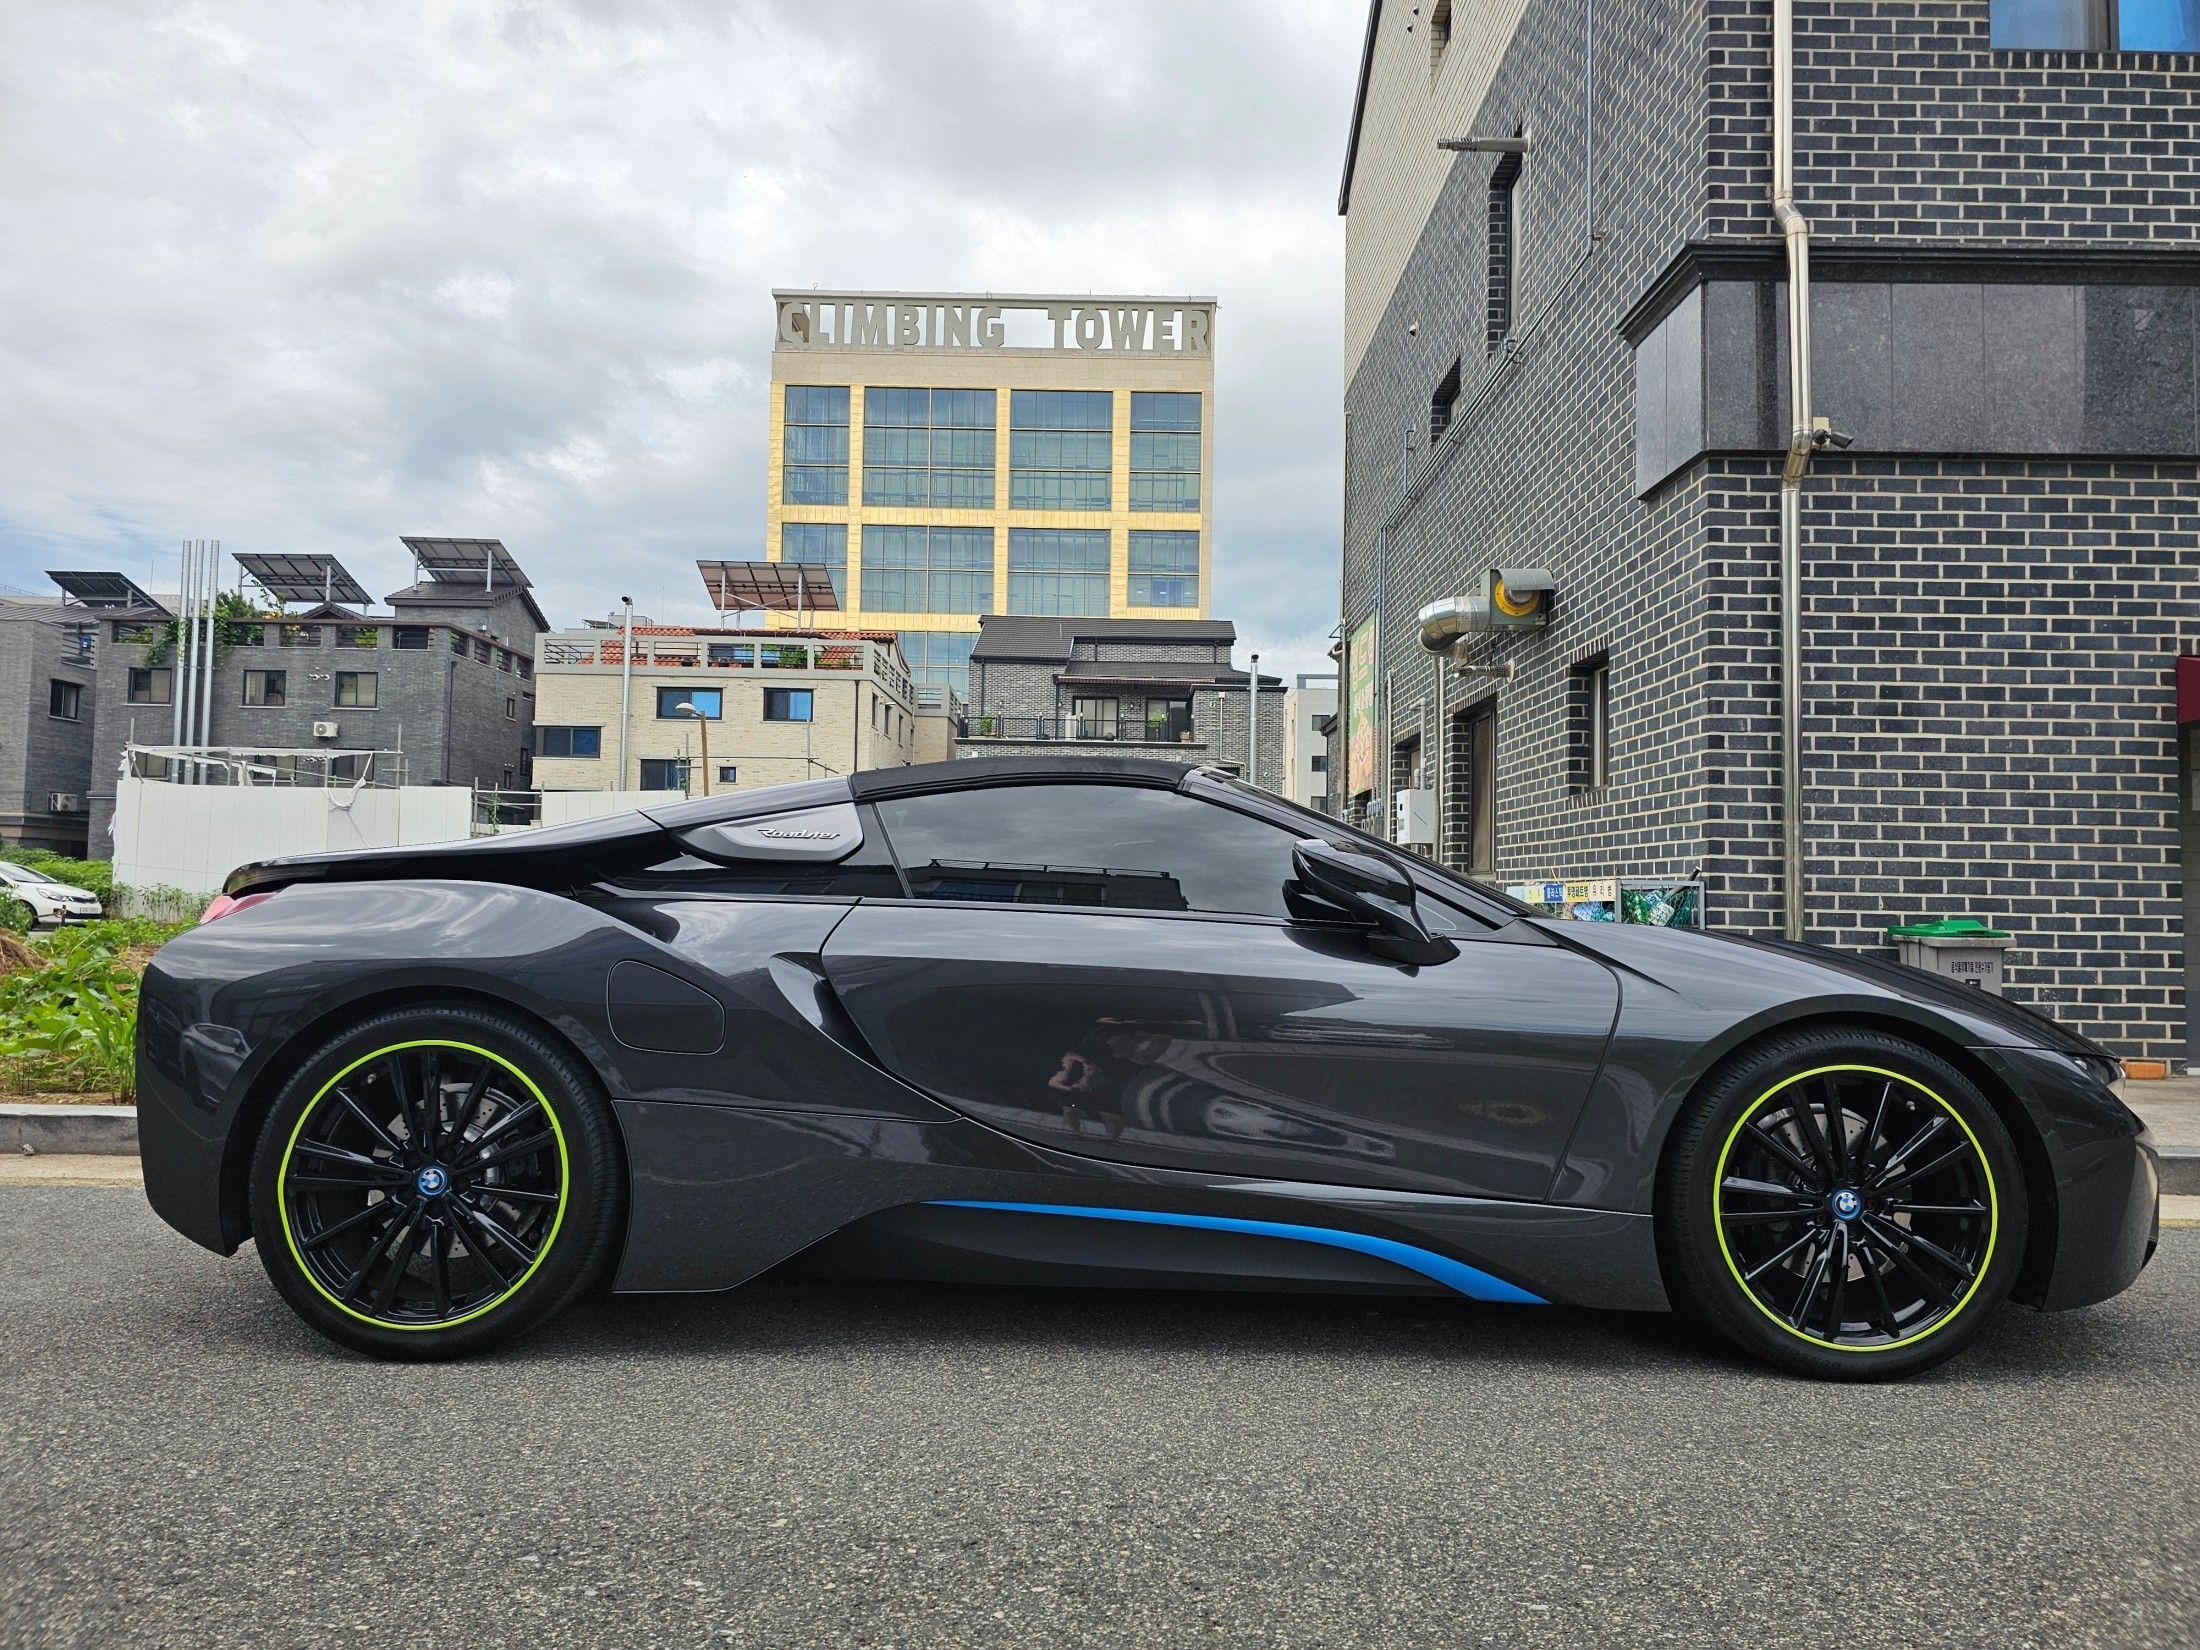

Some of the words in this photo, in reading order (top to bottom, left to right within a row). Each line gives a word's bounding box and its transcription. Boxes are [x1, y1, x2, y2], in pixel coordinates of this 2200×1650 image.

[779, 302, 1005, 348] CLIMBING
[1047, 307, 1210, 352] TOWER
[758, 828, 841, 840] Roadster
